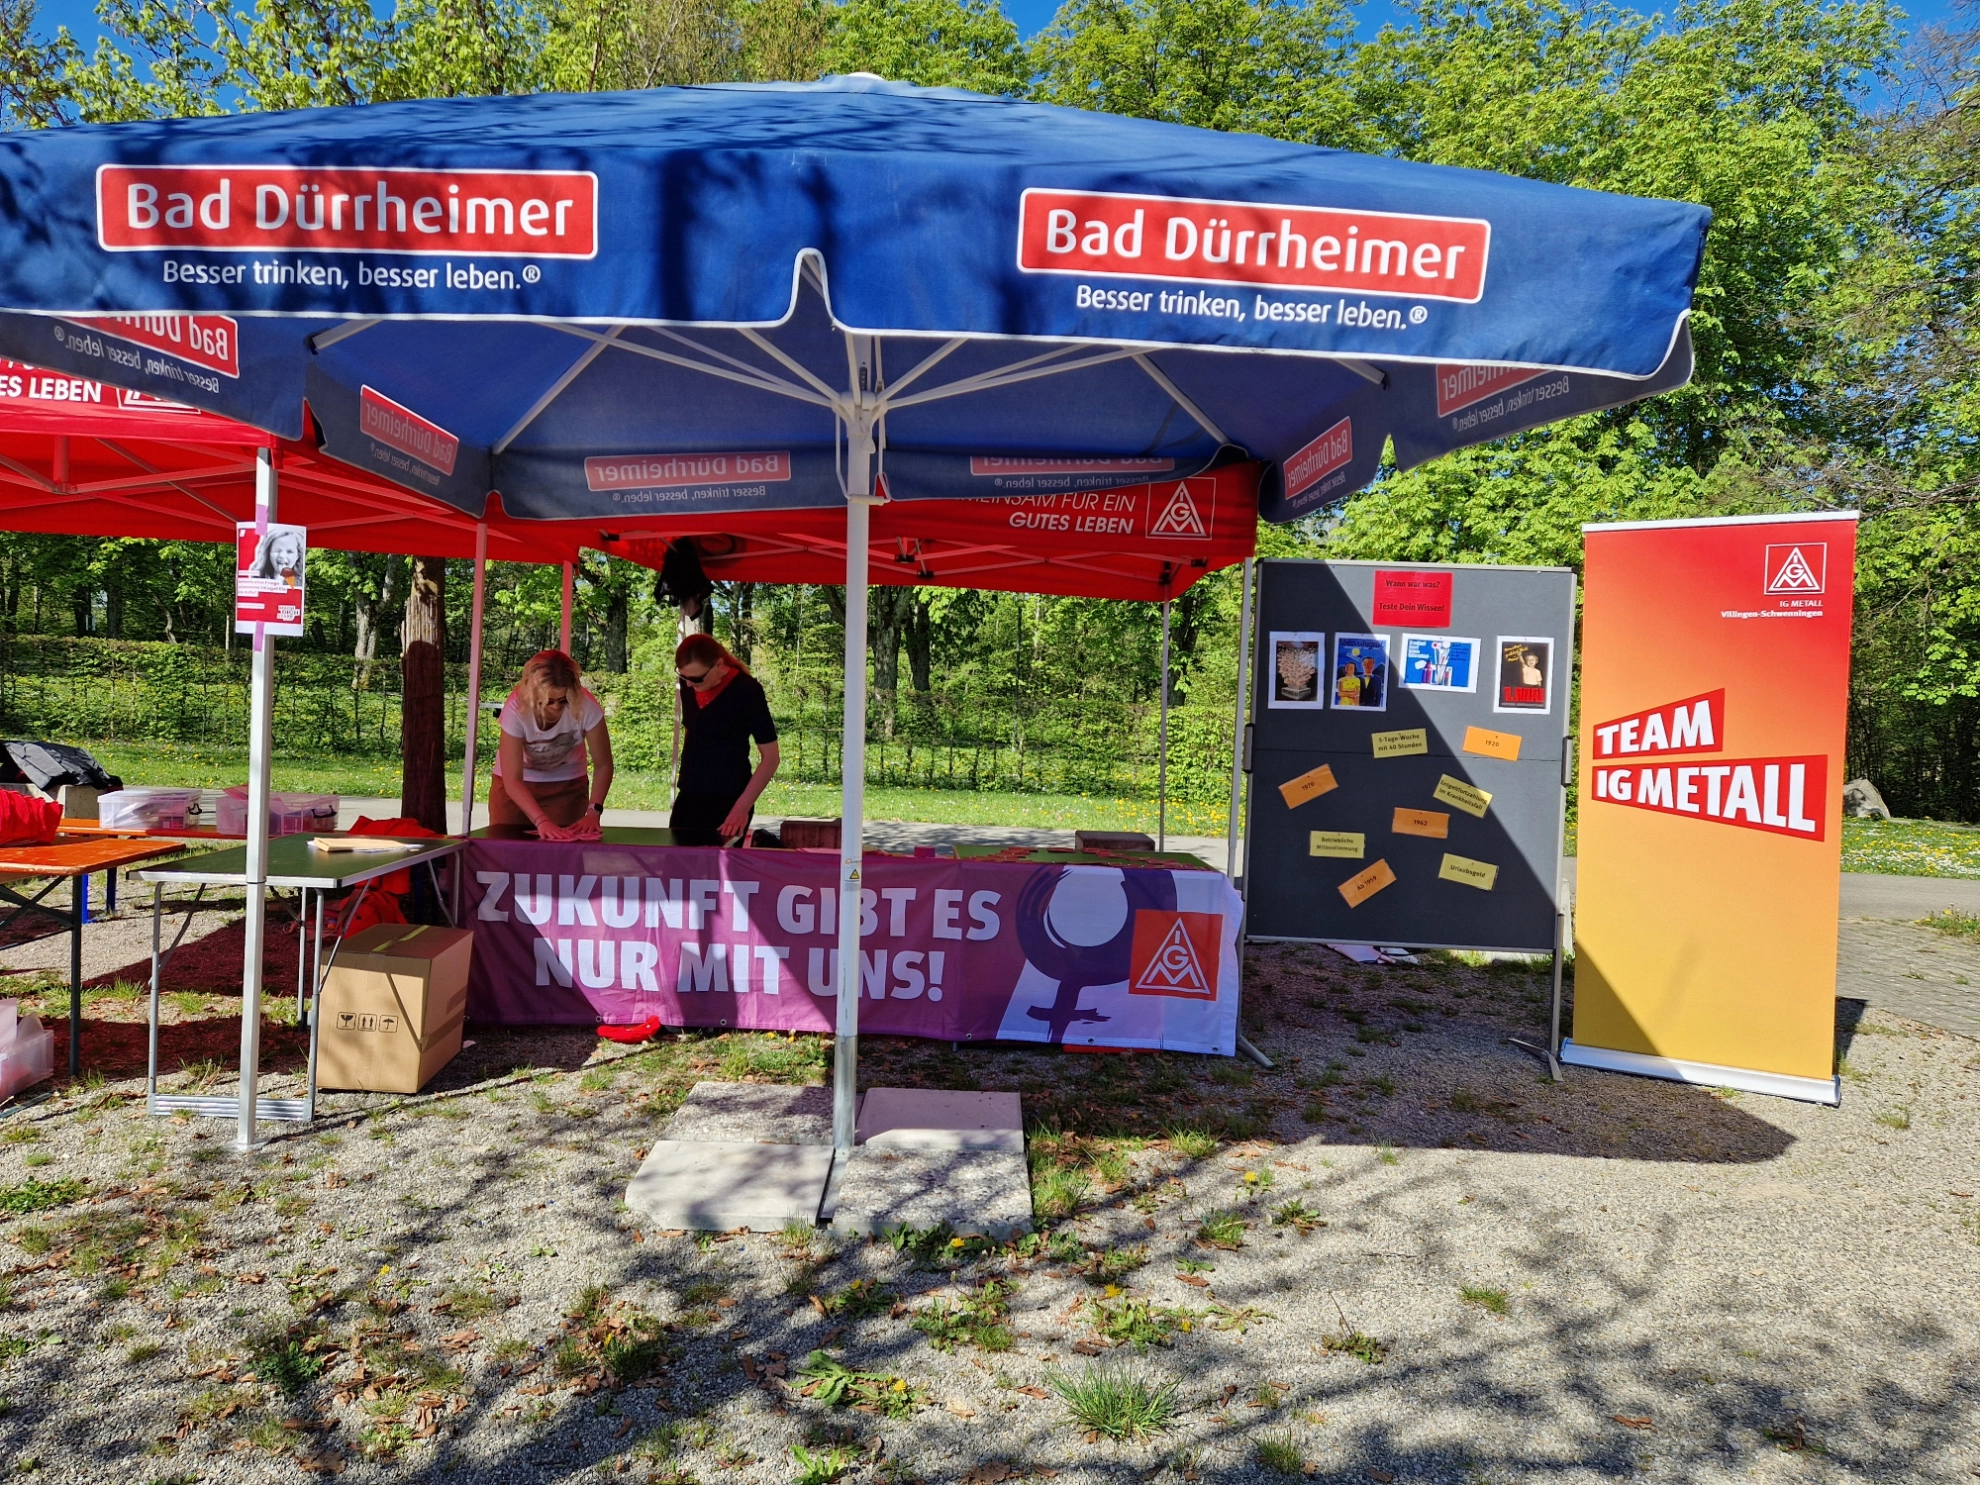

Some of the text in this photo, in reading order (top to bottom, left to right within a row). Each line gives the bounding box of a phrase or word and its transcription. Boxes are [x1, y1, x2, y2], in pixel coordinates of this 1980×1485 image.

[127, 178, 574, 236] Bad Dürrheimer
[1046, 208, 1465, 280] Bad Dürrheimer
[163, 260, 247, 284] Besser
[252, 260, 349, 289] trinken,
[359, 261, 438, 288] besser
[1076, 284, 1153, 311] Besser
[1159, 288, 1247, 320] trinken,
[1255, 295, 1329, 323] besser
[29, 377, 102, 403] LEBEN
[1103, 494, 1136, 512] EIN
[1009, 511, 1134, 534] GUTES LEBEN
[1417, 604, 1445, 612] Wissen!
[1721, 610, 1823, 619] Villingen-Schwenningen
[1597, 699, 1715, 755] TEAM
[1378, 733, 1419, 743] 5-Tage-Woche
[1398, 742, 1422, 750] Stunden
[1485, 739, 1500, 747] 1920
[1301, 781, 1315, 791] 1970
[1596, 763, 1816, 833] IG METALL
[1316, 844, 1358, 853] Mitbestimmung
[1450, 864, 1486, 878] Urlaubsgeld
[1356, 875, 1377, 891] Ab 1959
[476, 870, 760, 932] ZUKUNFT
[932, 888, 1002, 941] ES
[533, 937, 945, 1002] NUR MIT UNS!
